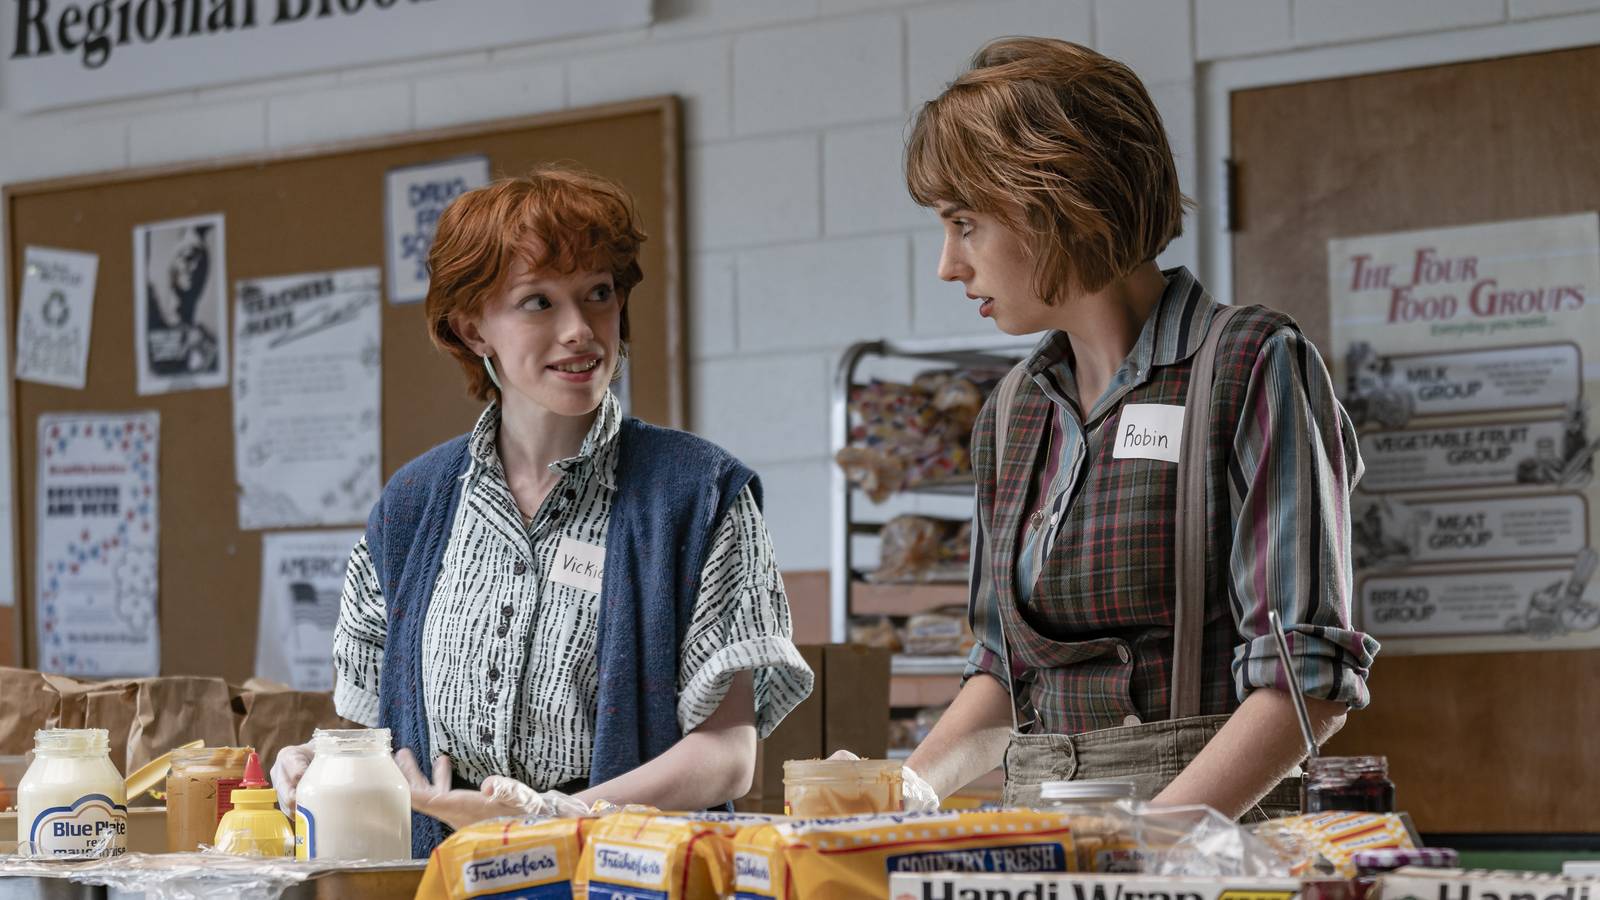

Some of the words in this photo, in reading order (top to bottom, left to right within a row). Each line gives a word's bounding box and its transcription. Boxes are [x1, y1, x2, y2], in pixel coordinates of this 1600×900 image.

[9, 0, 258, 69] Regional
[1387, 284, 1459, 324] FOOD
[1468, 278, 1585, 317] GROUPS
[1406, 366, 1449, 383] MILK
[1418, 381, 1483, 401] GROUP
[1124, 424, 1168, 449] Robin
[1446, 448, 1512, 466] GROUP
[1436, 513, 1487, 531] MEAT
[1428, 531, 1493, 549] GROUP
[1369, 586, 1430, 606] BREAD
[1372, 604, 1437, 625] GROUP
[53, 822, 93, 837] Blue
[897, 850, 991, 873] COUNTRY
[992, 844, 1057, 871] FRESH
[466, 855, 556, 883] Freihofer's
